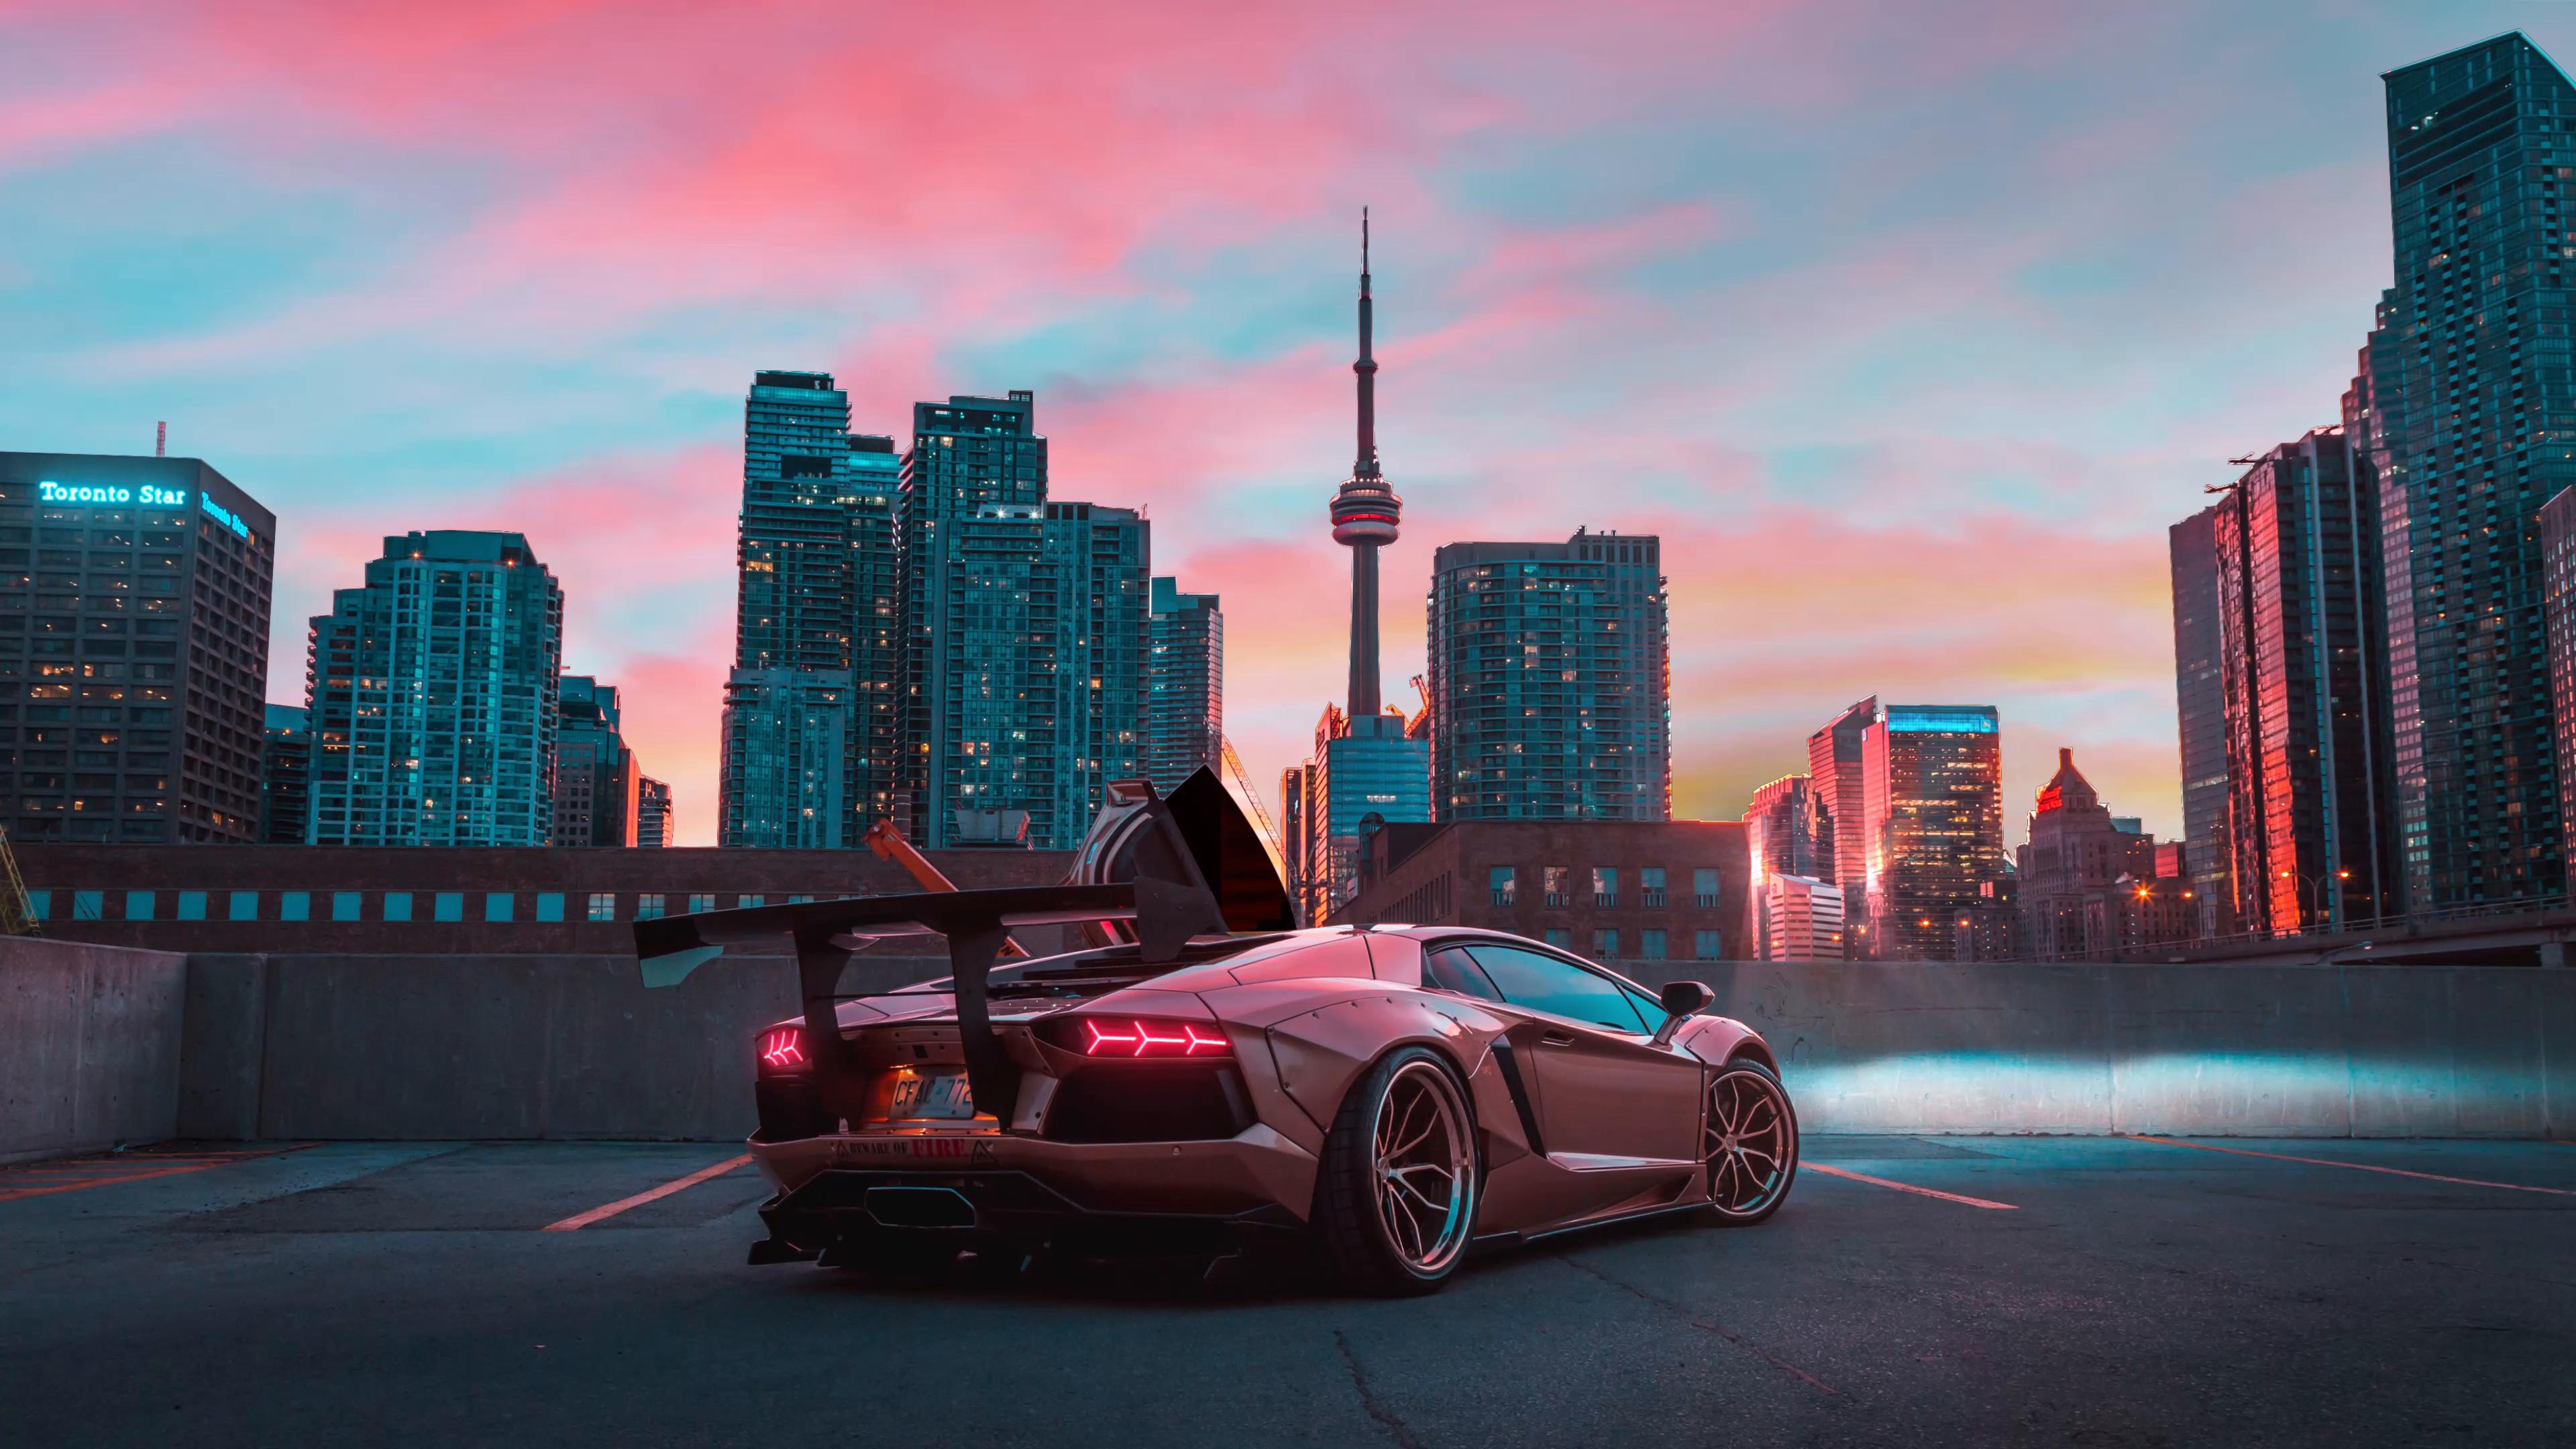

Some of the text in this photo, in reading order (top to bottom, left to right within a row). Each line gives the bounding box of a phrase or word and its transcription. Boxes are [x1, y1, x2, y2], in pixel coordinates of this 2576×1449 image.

[40, 481, 186, 504] Toronto Star
[201, 492, 248, 538] Toronto Star
[849, 1138, 968, 1158] BEWARE OF FIRE
